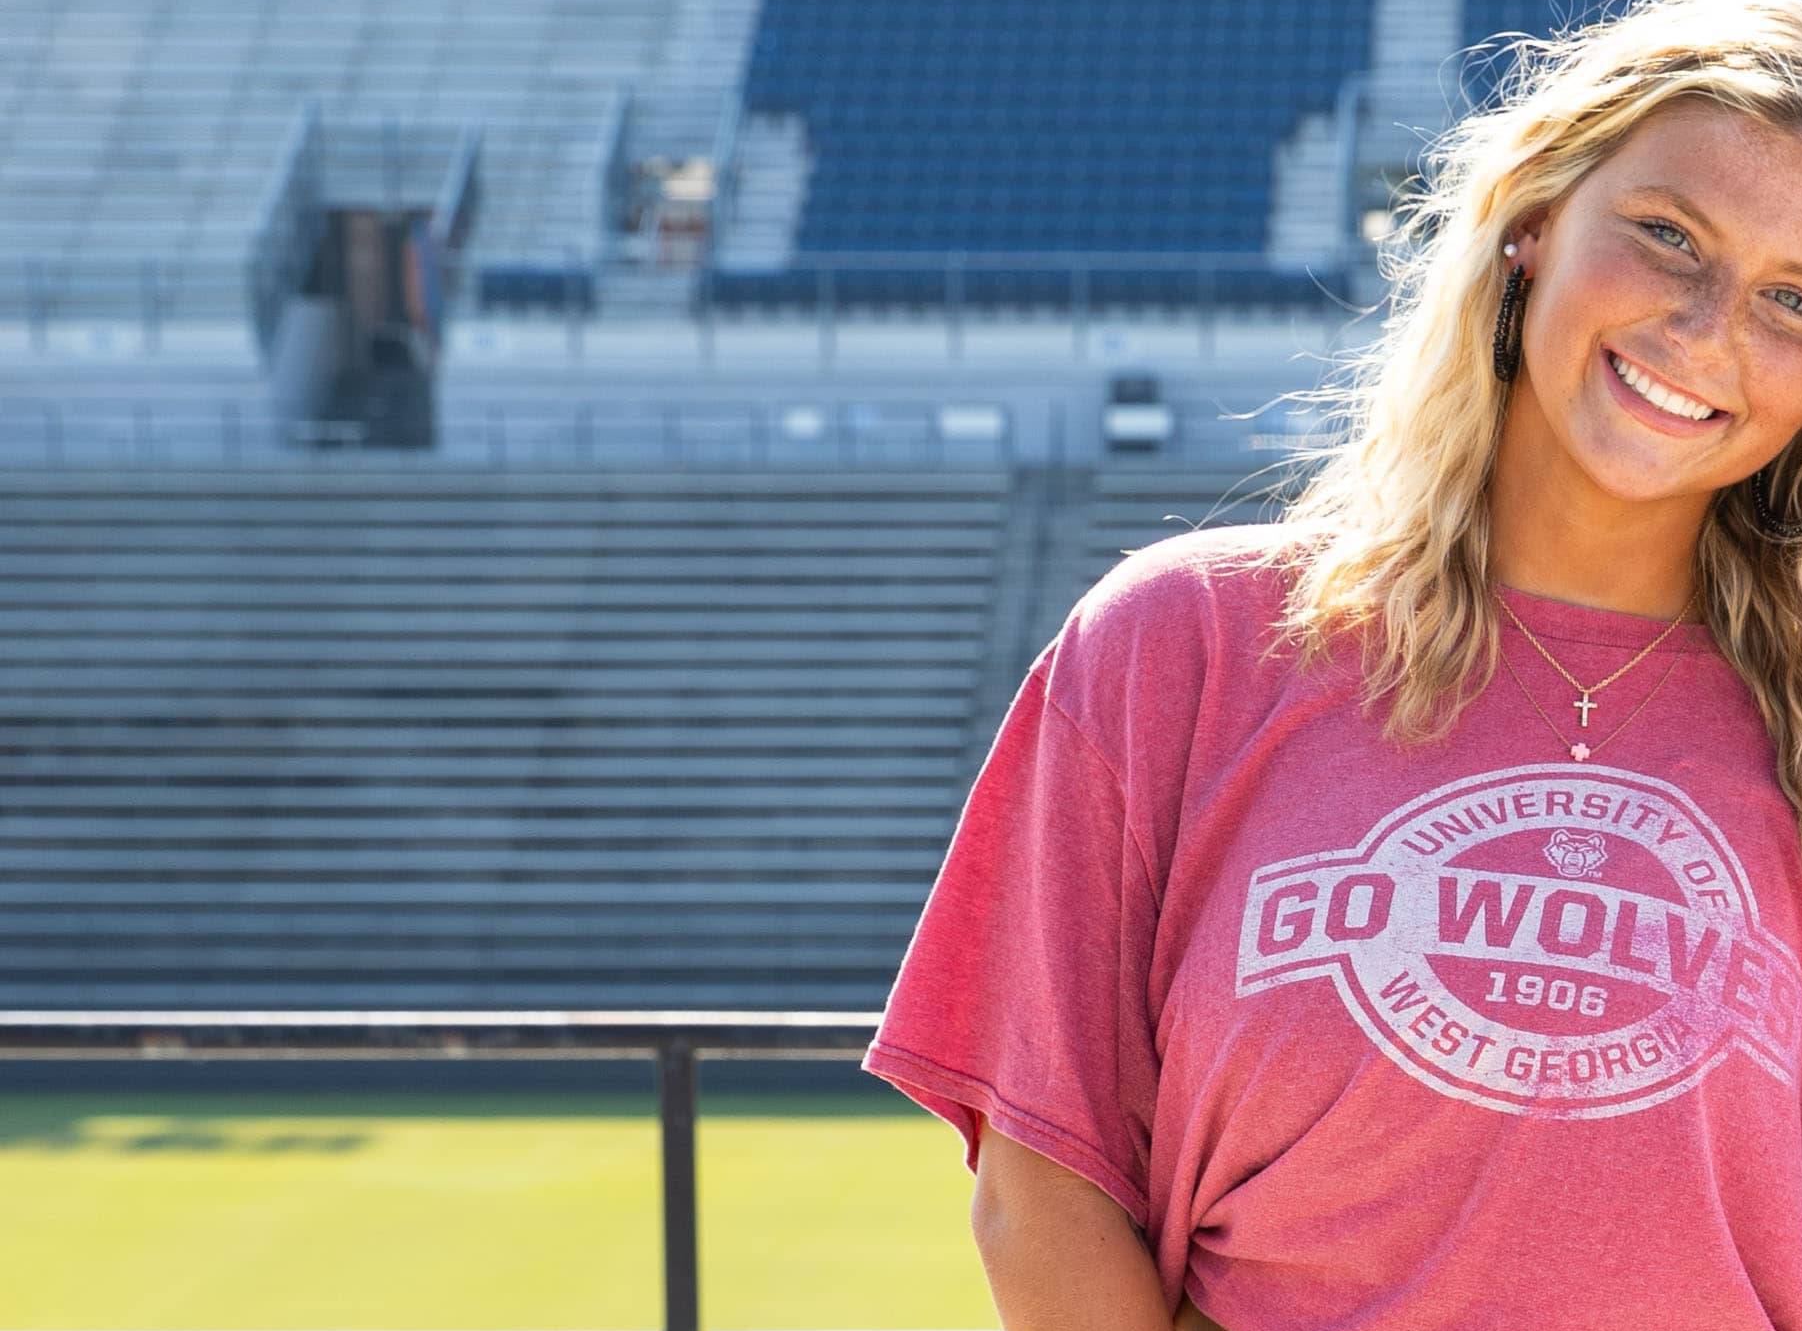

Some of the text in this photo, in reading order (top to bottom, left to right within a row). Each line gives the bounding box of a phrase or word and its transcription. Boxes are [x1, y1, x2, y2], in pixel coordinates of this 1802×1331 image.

[1401, 790, 1731, 909] UNIVERSITY OF
[1256, 872, 1797, 1048] GO WOLVES
[1484, 971, 1609, 1017] 1906
[1379, 970, 1695, 1084] WEST GEORGIA
